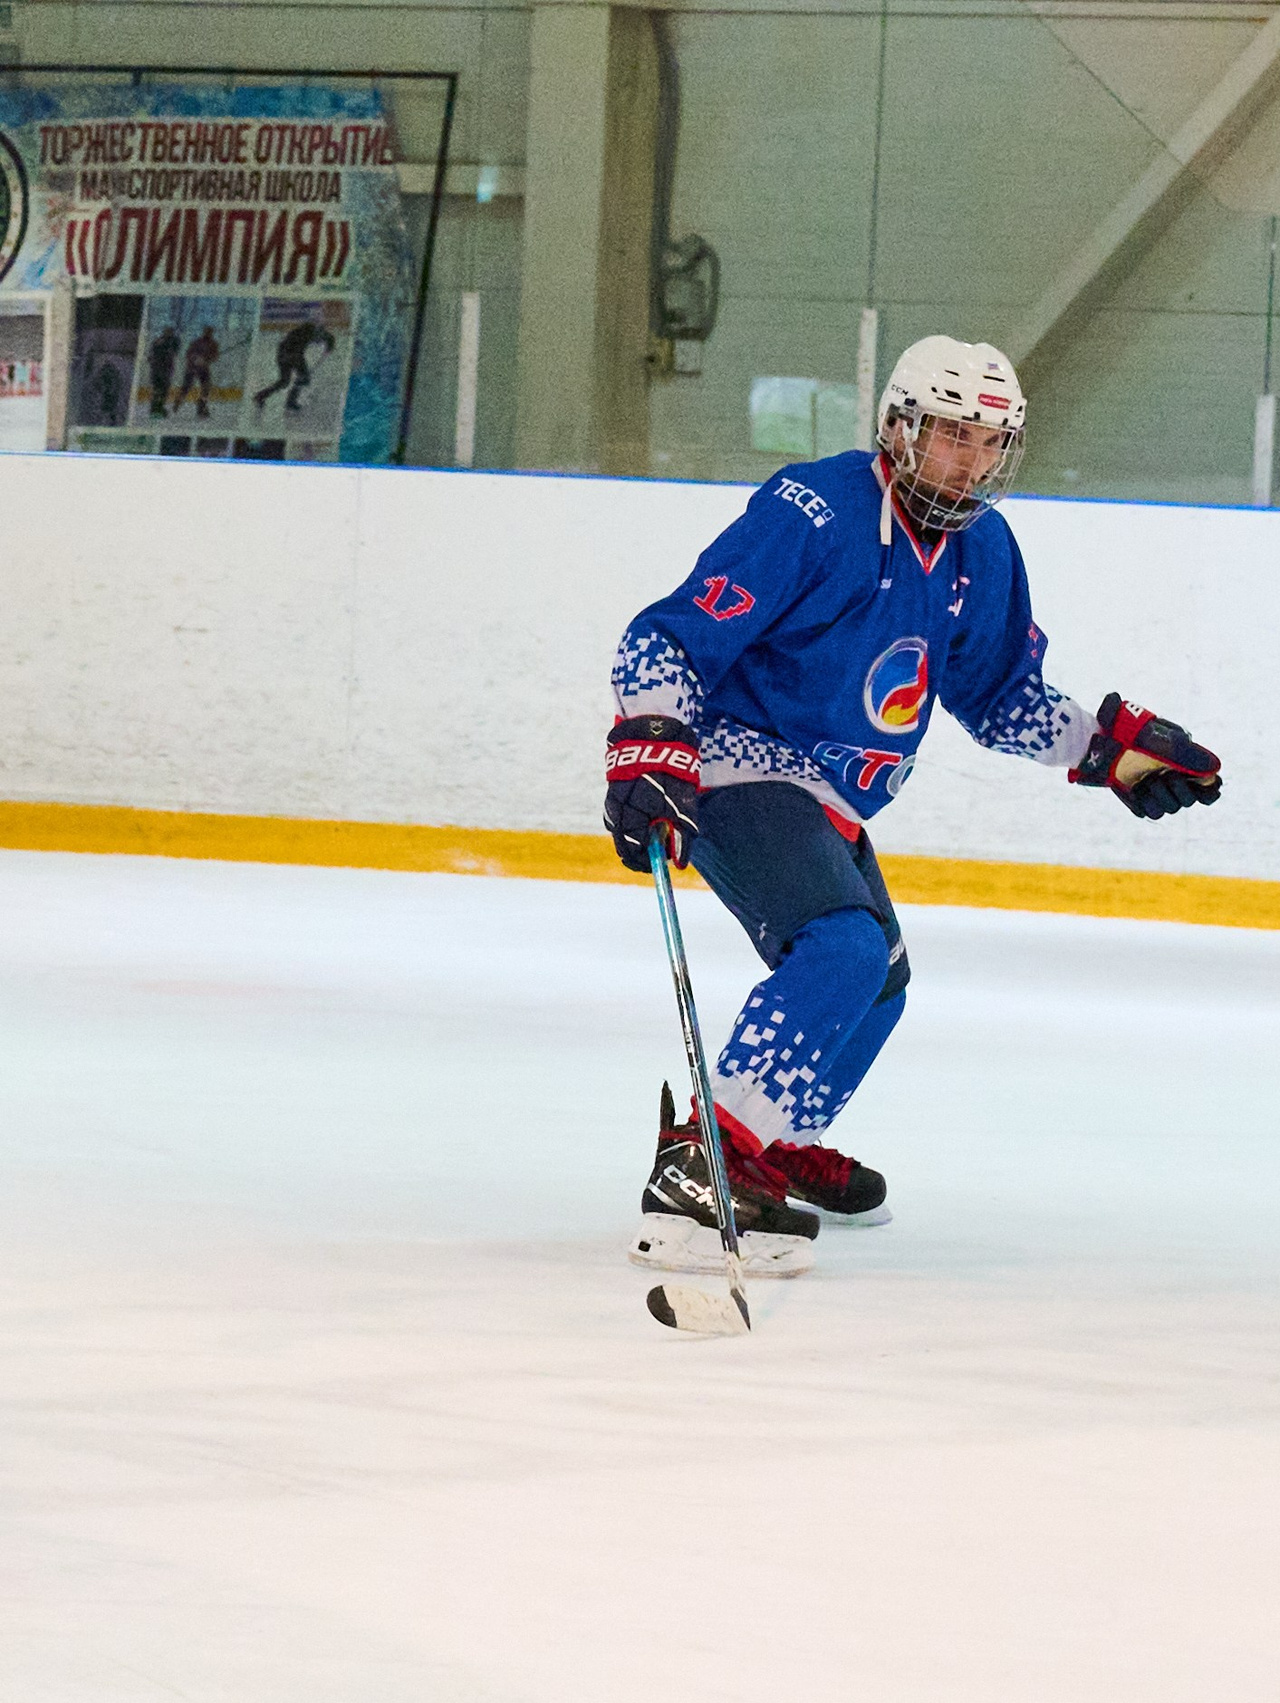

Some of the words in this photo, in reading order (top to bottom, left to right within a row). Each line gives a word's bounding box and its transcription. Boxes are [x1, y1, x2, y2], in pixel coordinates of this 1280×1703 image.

[40, 122, 251, 165] ТОРЖЕСТВЕННОЕ
[255, 124, 397, 165] ОТКРЫТИЕ
[128, 169, 262, 200] СПОРТИВНАЯ
[265, 171, 341, 201] ШКОЛА
[693, 574, 756, 621] 17
